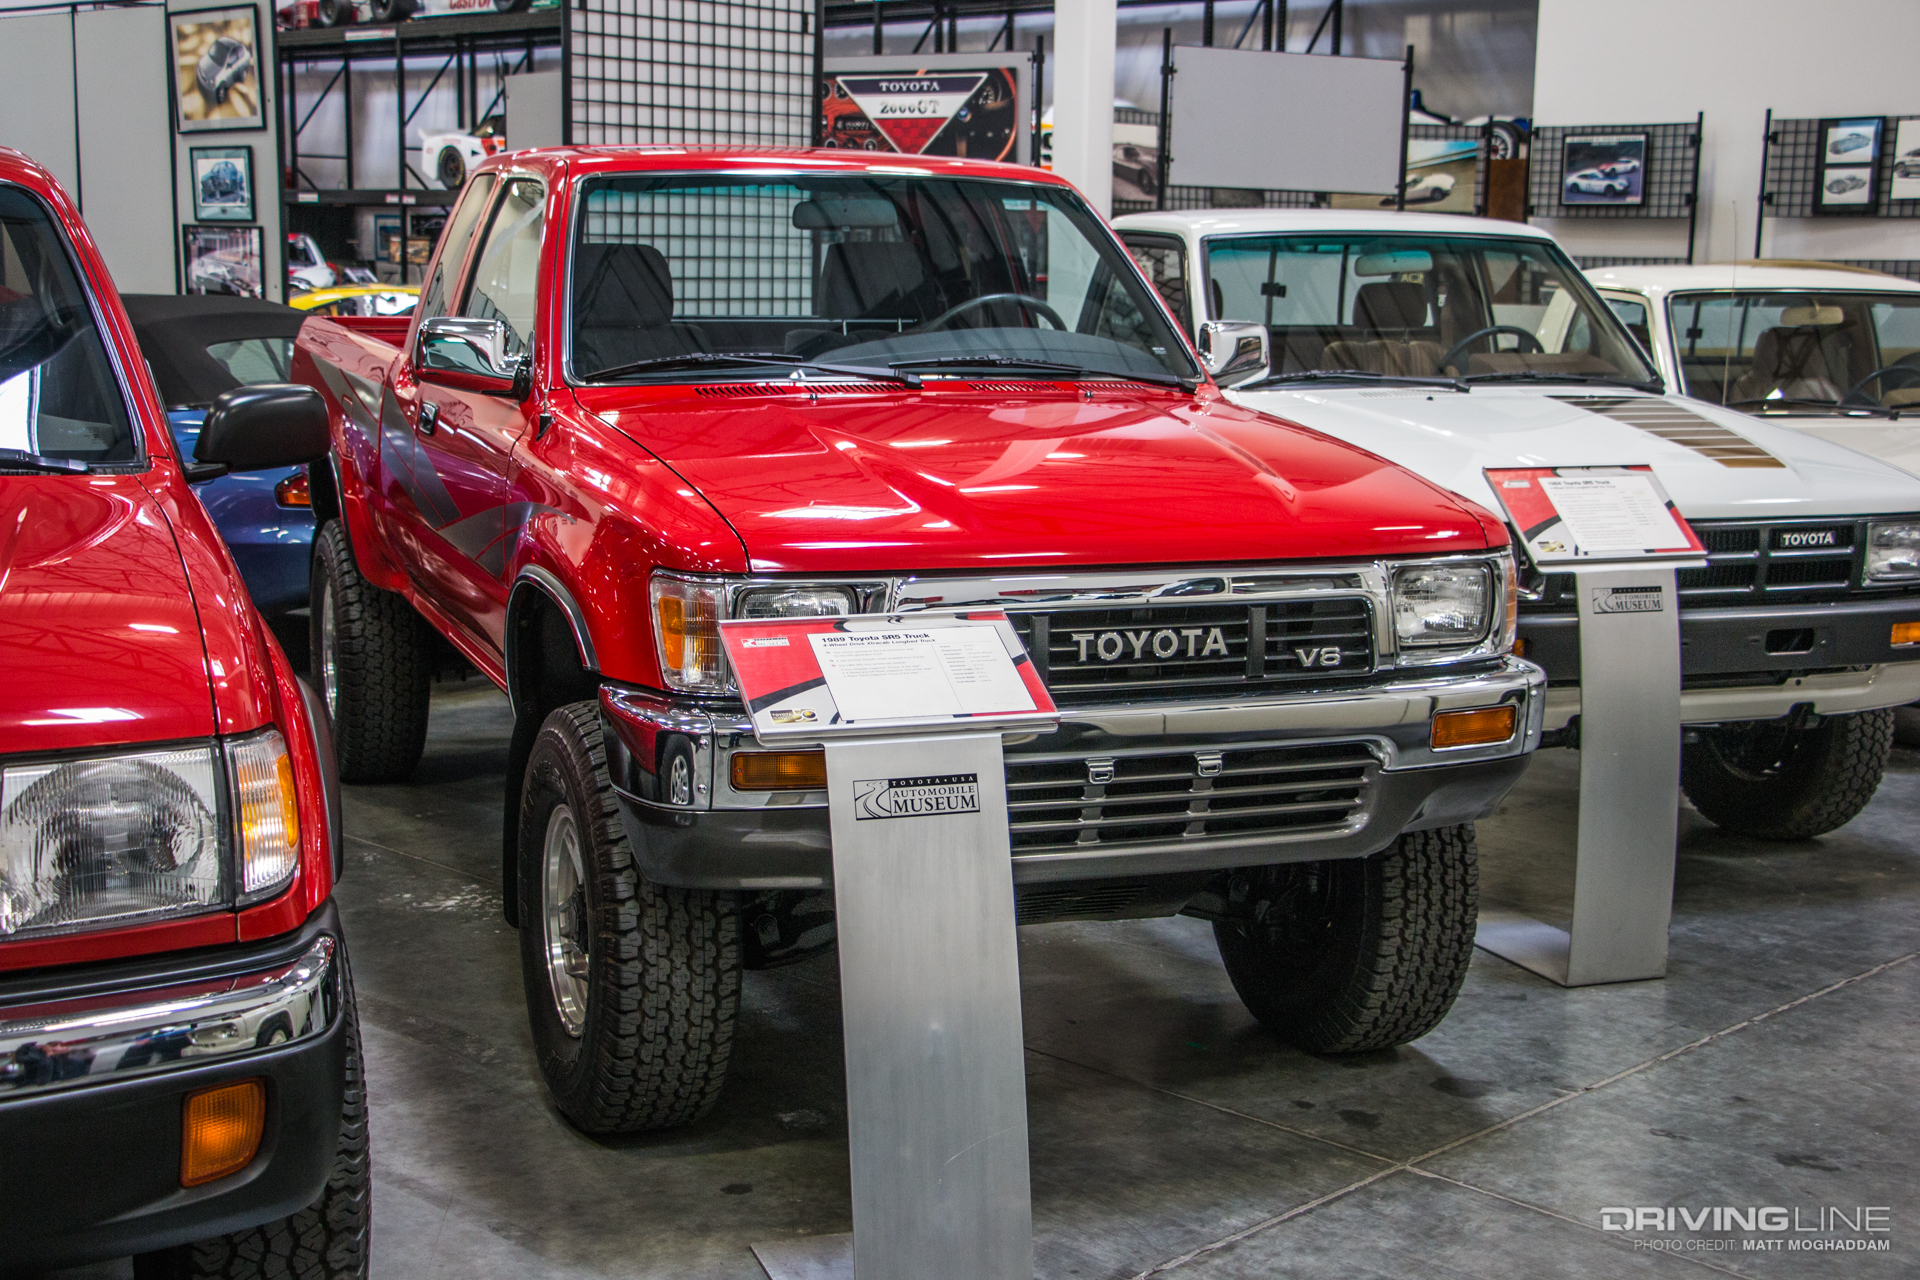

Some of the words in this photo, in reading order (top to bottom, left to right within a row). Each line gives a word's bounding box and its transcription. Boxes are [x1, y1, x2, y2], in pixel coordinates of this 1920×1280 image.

[878, 81, 940, 92] TOYOTA
[879, 99, 940, 115] 2000GT
[1782, 531, 1835, 546] TOYOTA
[1614, 599, 1661, 611] MUSEUM
[1071, 627, 1229, 662] TOYOTA
[1295, 646, 1342, 667] V6
[891, 778, 941, 787] TOYOTA
[952, 775, 974, 783] USA
[892, 785, 975, 799] AUTOMOBILE
[893, 794, 977, 814] MUSEUM
